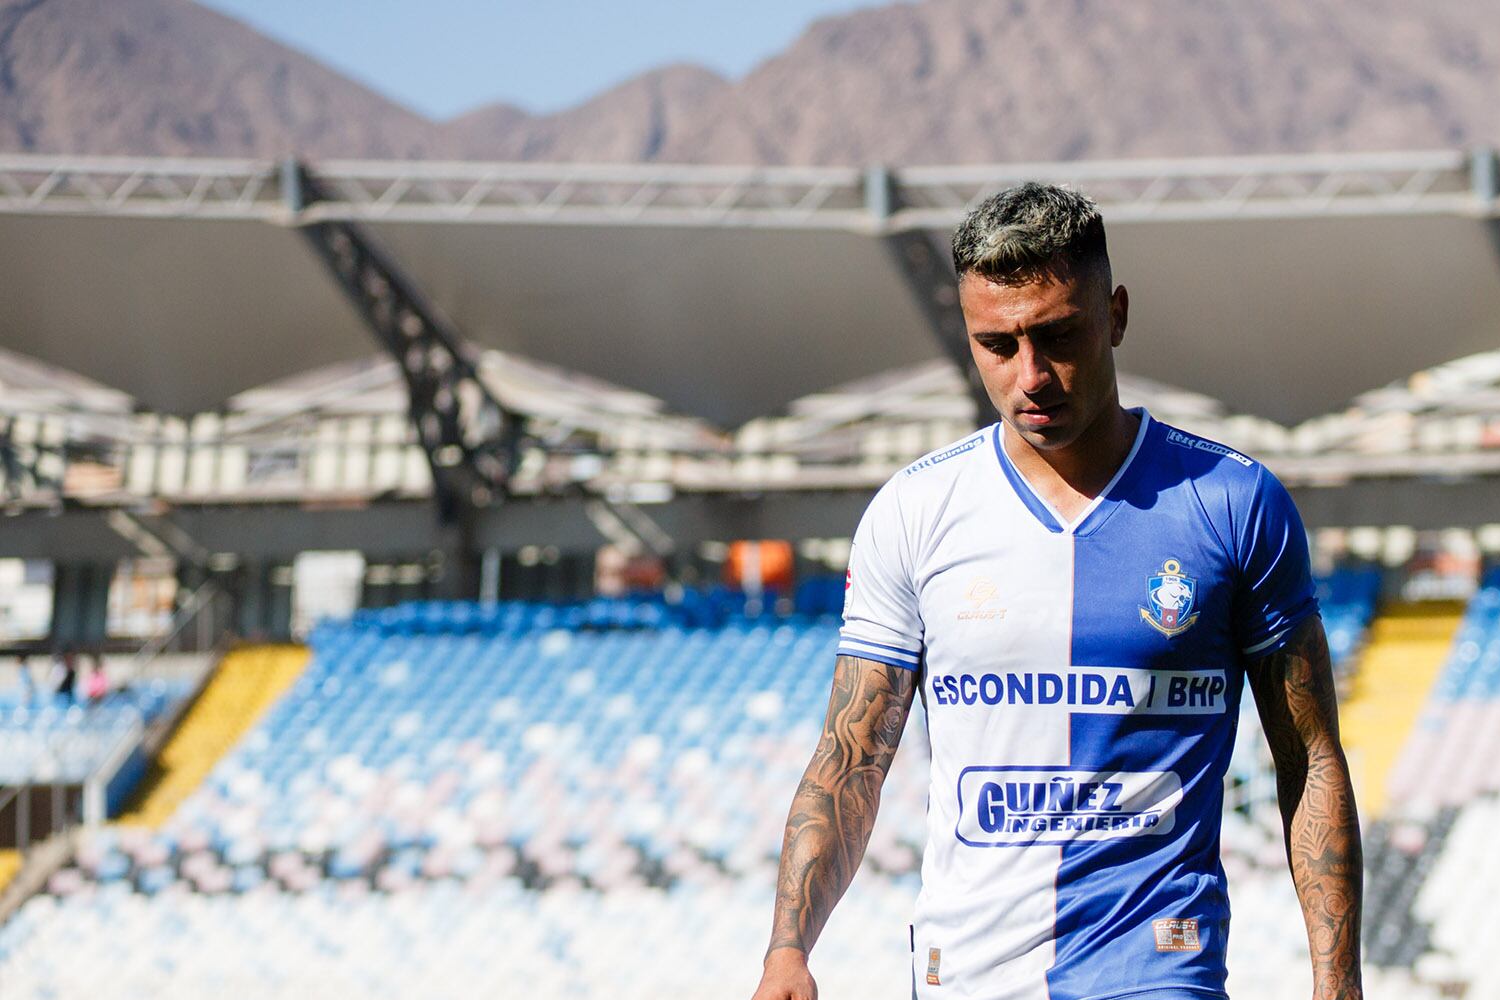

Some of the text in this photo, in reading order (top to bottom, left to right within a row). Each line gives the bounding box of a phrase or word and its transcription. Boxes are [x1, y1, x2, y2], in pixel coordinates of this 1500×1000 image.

[932, 673, 1226, 708] ESCONDIDA BHP
[978, 776, 1123, 833] GUIÑEZ
[1004, 814, 1160, 833] INGENIERIA
